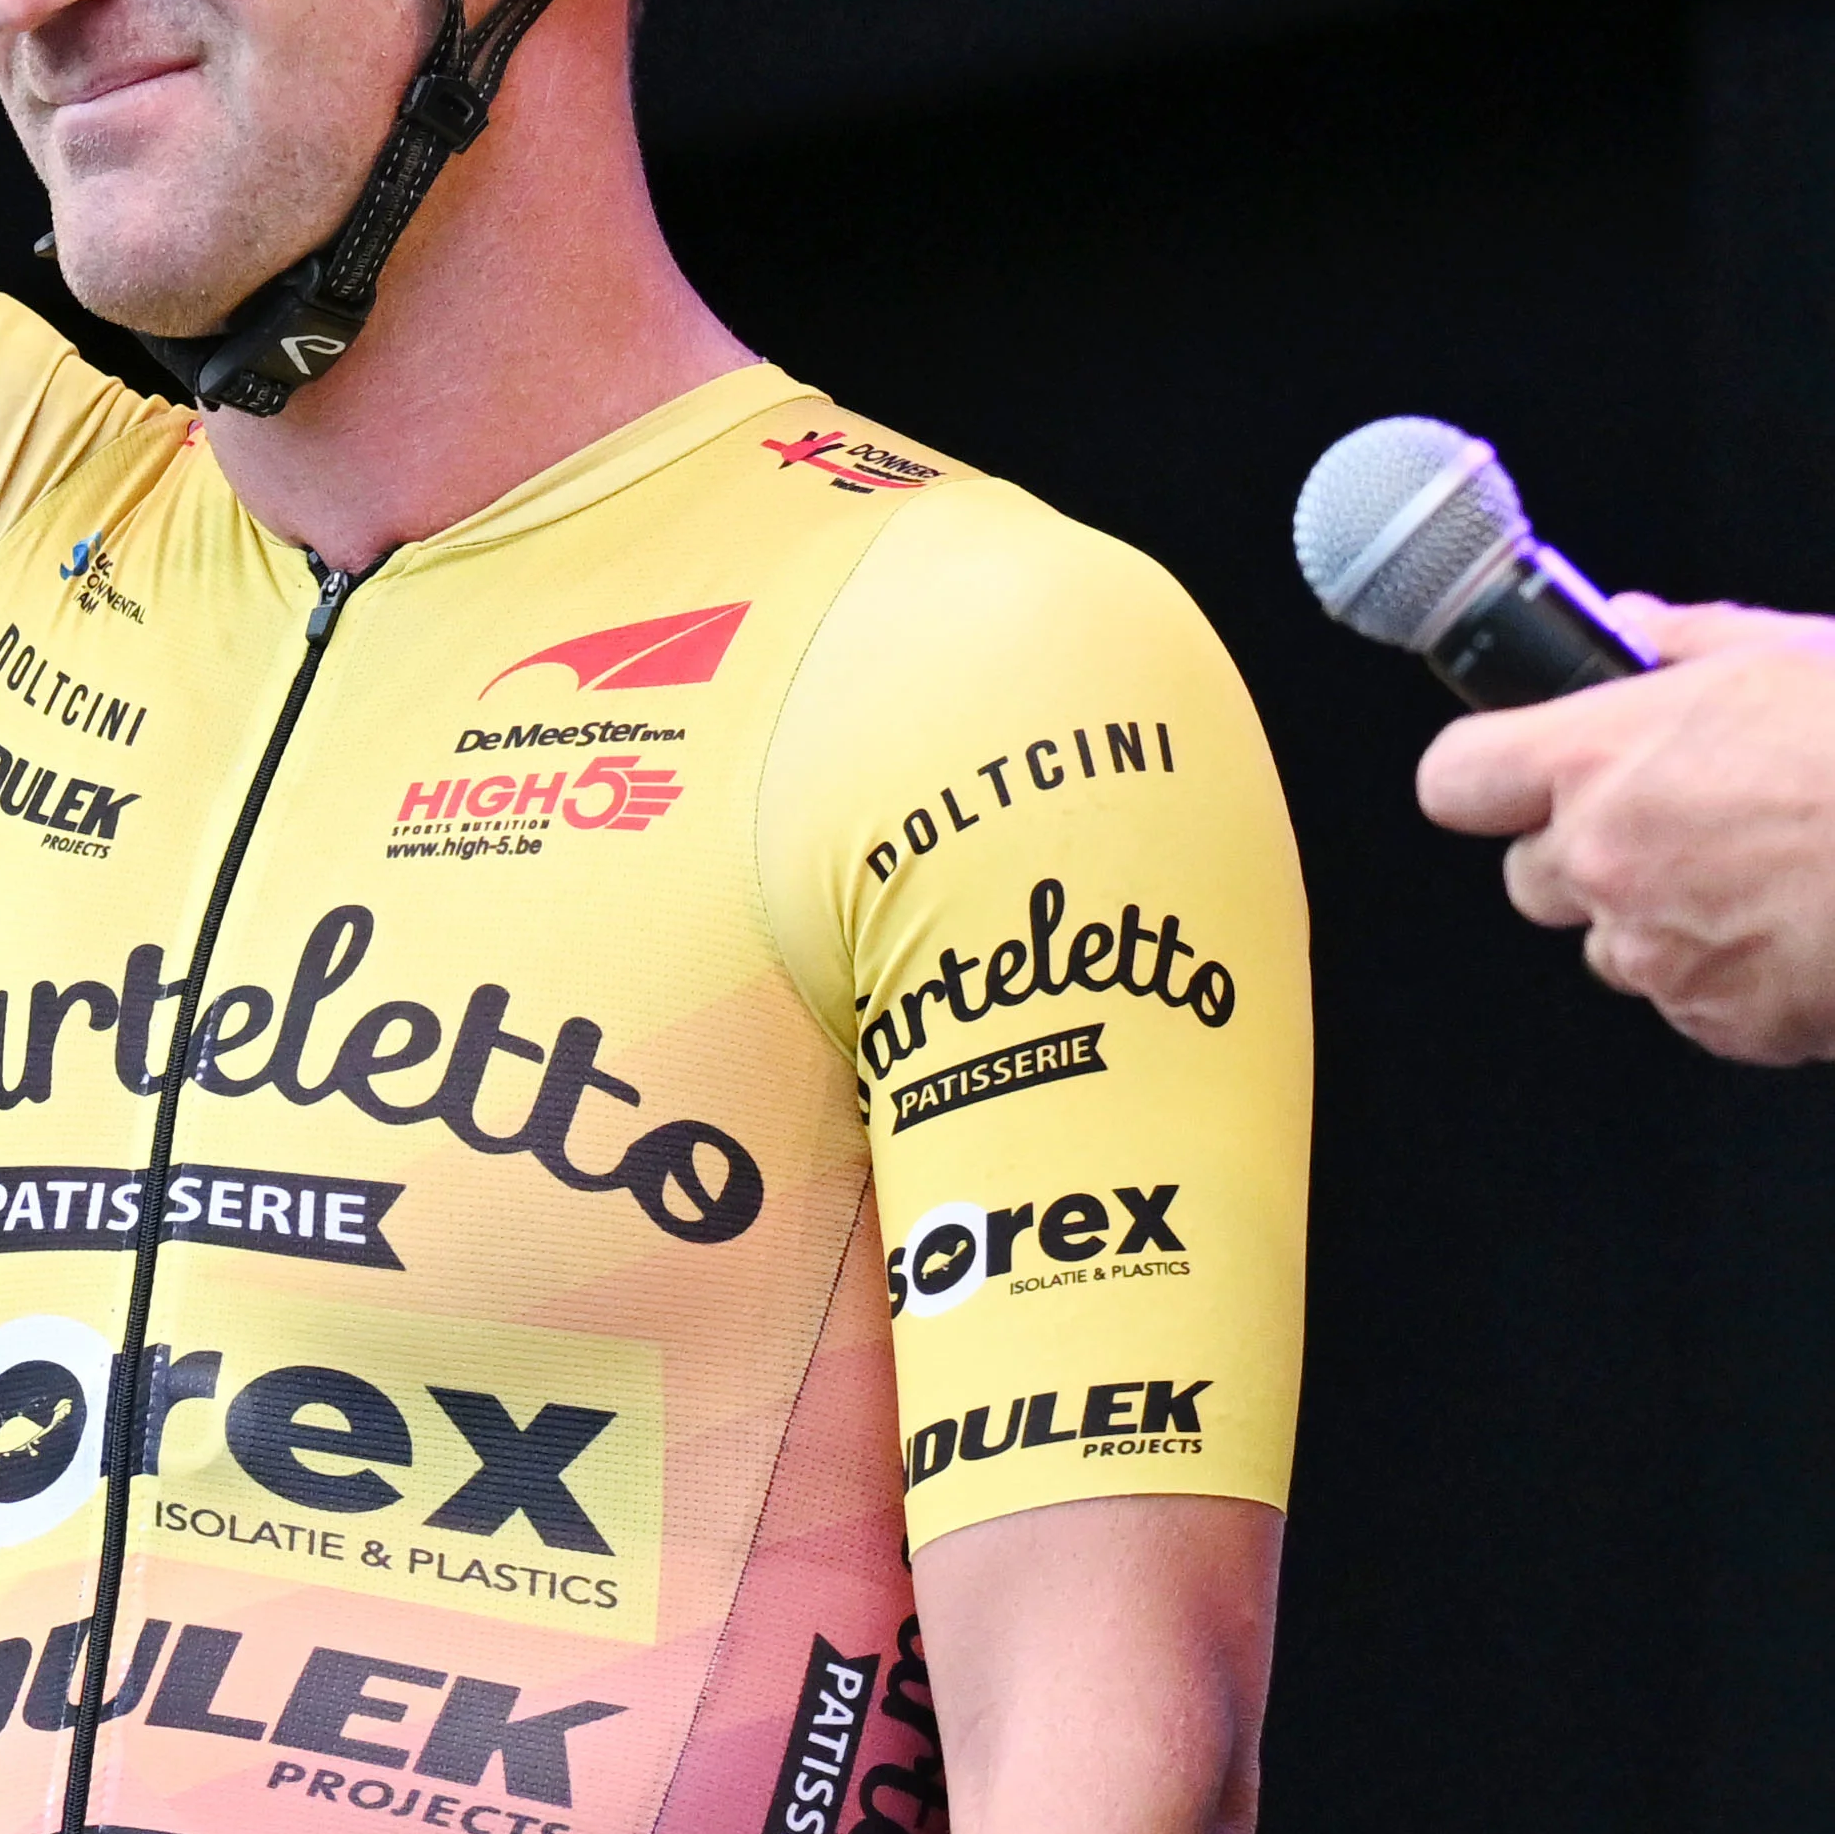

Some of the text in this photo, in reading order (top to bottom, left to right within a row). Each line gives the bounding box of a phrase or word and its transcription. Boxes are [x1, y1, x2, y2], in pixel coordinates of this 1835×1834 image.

[866, 722, 1175, 883] DOLTCINI
[391, 819, 551, 837] SPORTS NUTRITION
[41, 833, 111, 859] PROJECTS
[386, 836, 543, 860] www.high-5.be
[856, 878, 1235, 1082] arteletto
[900, 1035, 1092, 1119] PATISSERIE
[1010, 1261, 1191, 1296] ISOLATIE & PLASTICS
[1082, 1438, 1203, 1459] PROJECTS
[155, 1501, 619, 1610] ISOLATIE & PLASTICS
